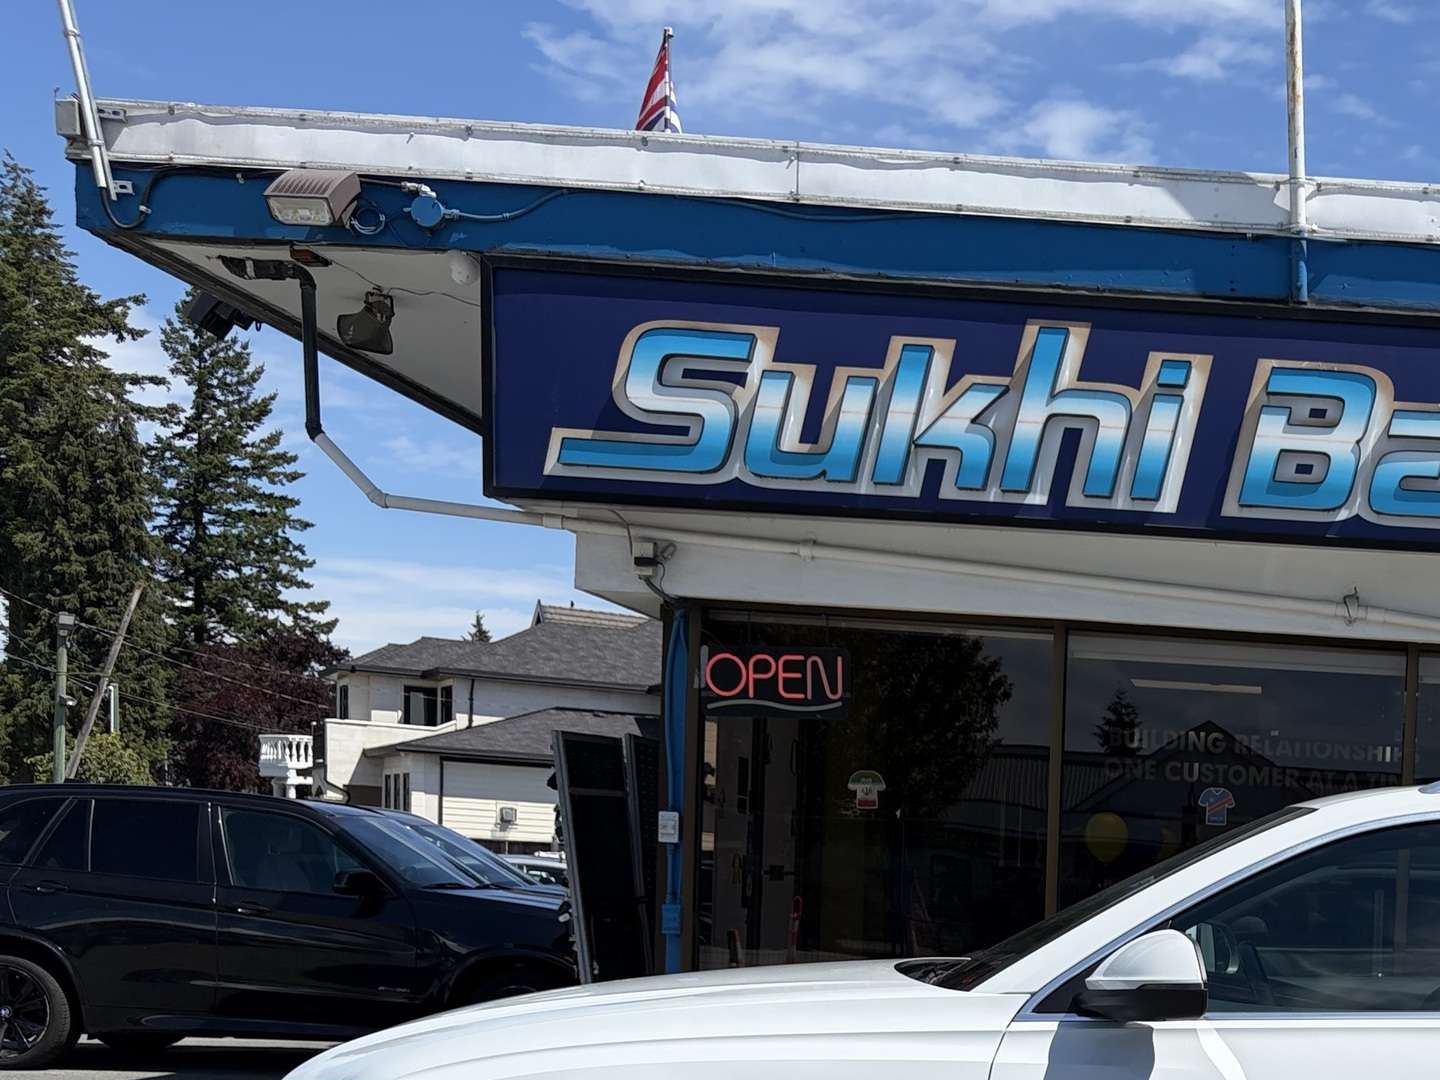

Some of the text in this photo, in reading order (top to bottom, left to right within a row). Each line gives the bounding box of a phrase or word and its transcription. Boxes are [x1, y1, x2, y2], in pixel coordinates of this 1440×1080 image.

[543, 319, 1214, 513] Sukhi
[704, 652, 845, 700] OPEN
[1108, 727, 1226, 752] BUILDING
[1103, 758, 1156, 780] ONE
[1166, 761, 1302, 788] CUSTOMER
